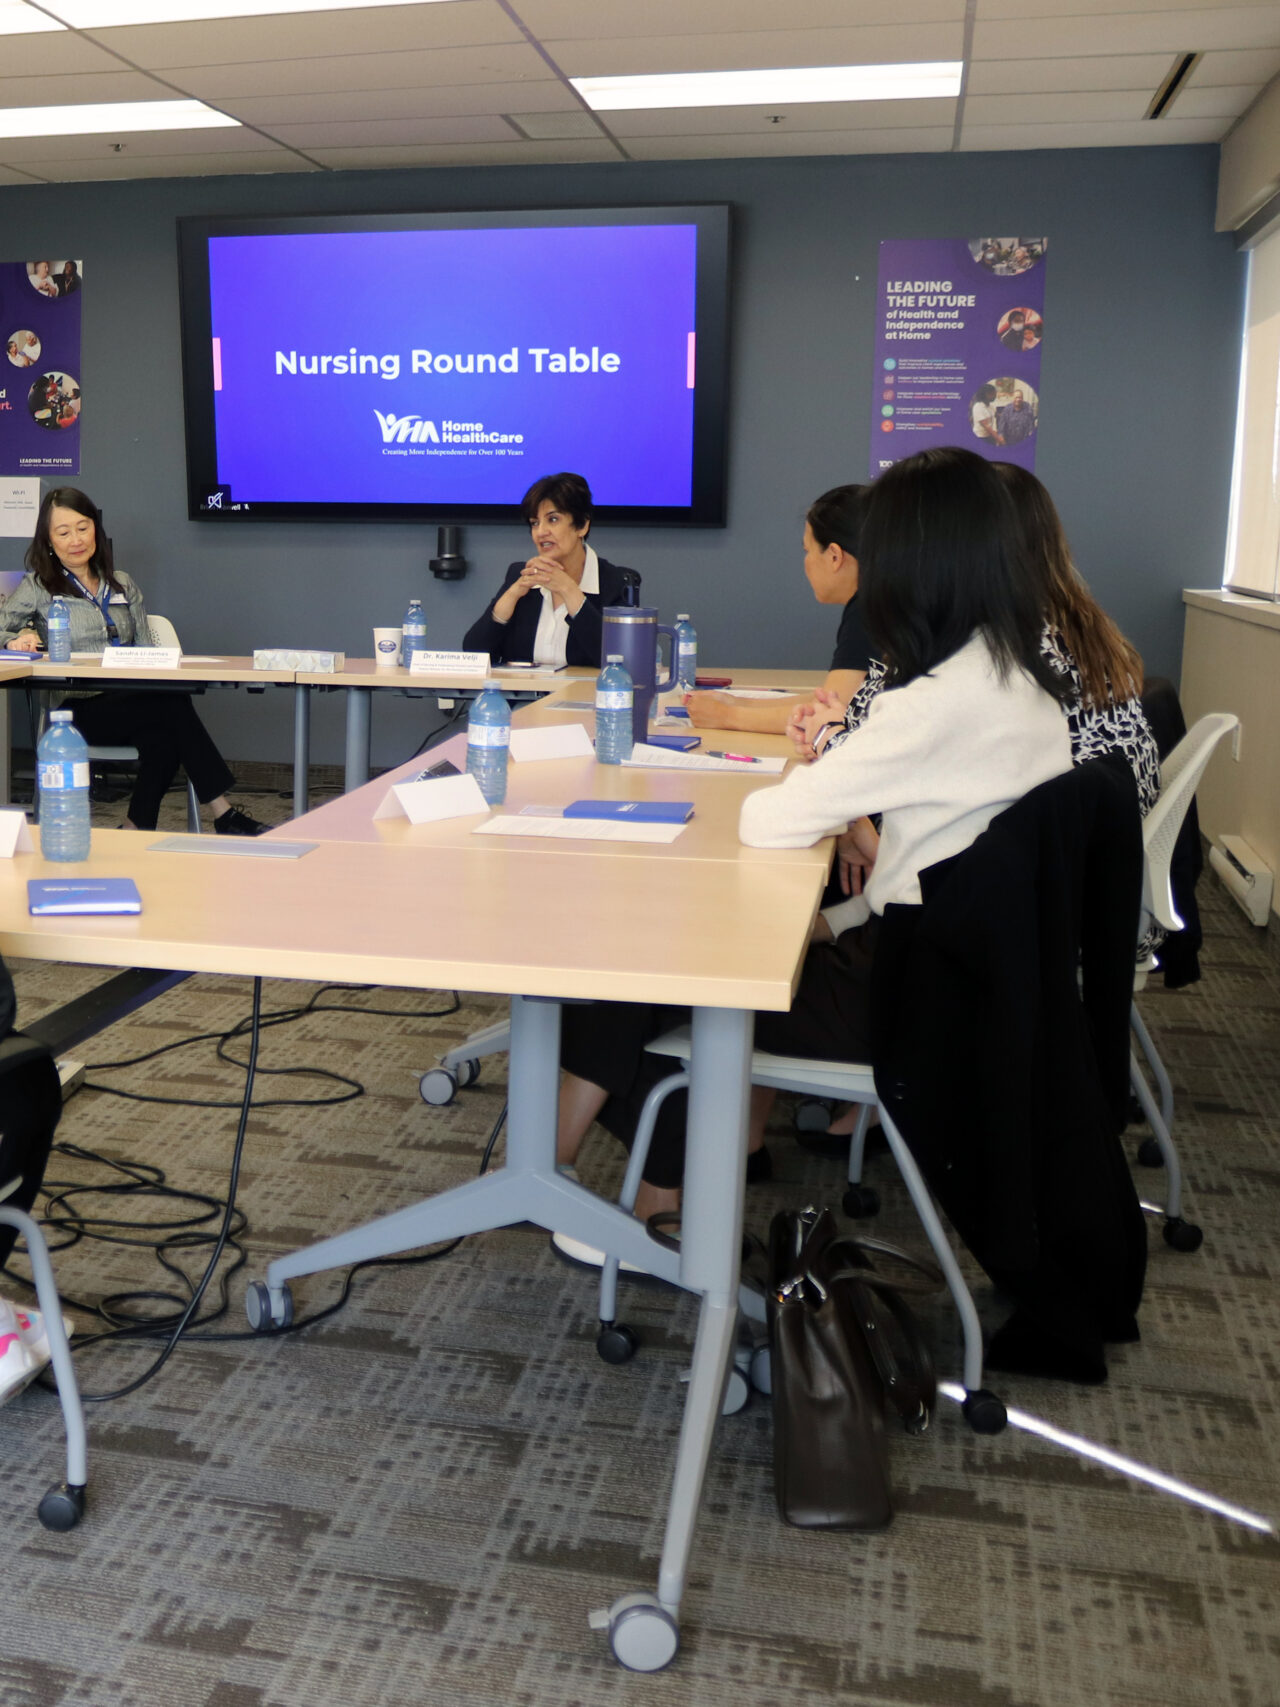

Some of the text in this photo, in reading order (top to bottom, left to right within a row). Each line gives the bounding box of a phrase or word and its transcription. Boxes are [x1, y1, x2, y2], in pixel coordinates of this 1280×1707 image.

[887, 281, 953, 293] LEADING
[887, 295, 976, 308] THE FUTURE
[886, 310, 959, 320] of Health and
[886, 321, 965, 332] Independence
[885, 331, 931, 341] at Home
[275, 347, 621, 380] Nursing Round Table
[373, 409, 484, 443] VHA Home
[442, 432, 524, 444] HealthCare
[382, 448, 524, 457] Creating More Independence for Over 100 Years
